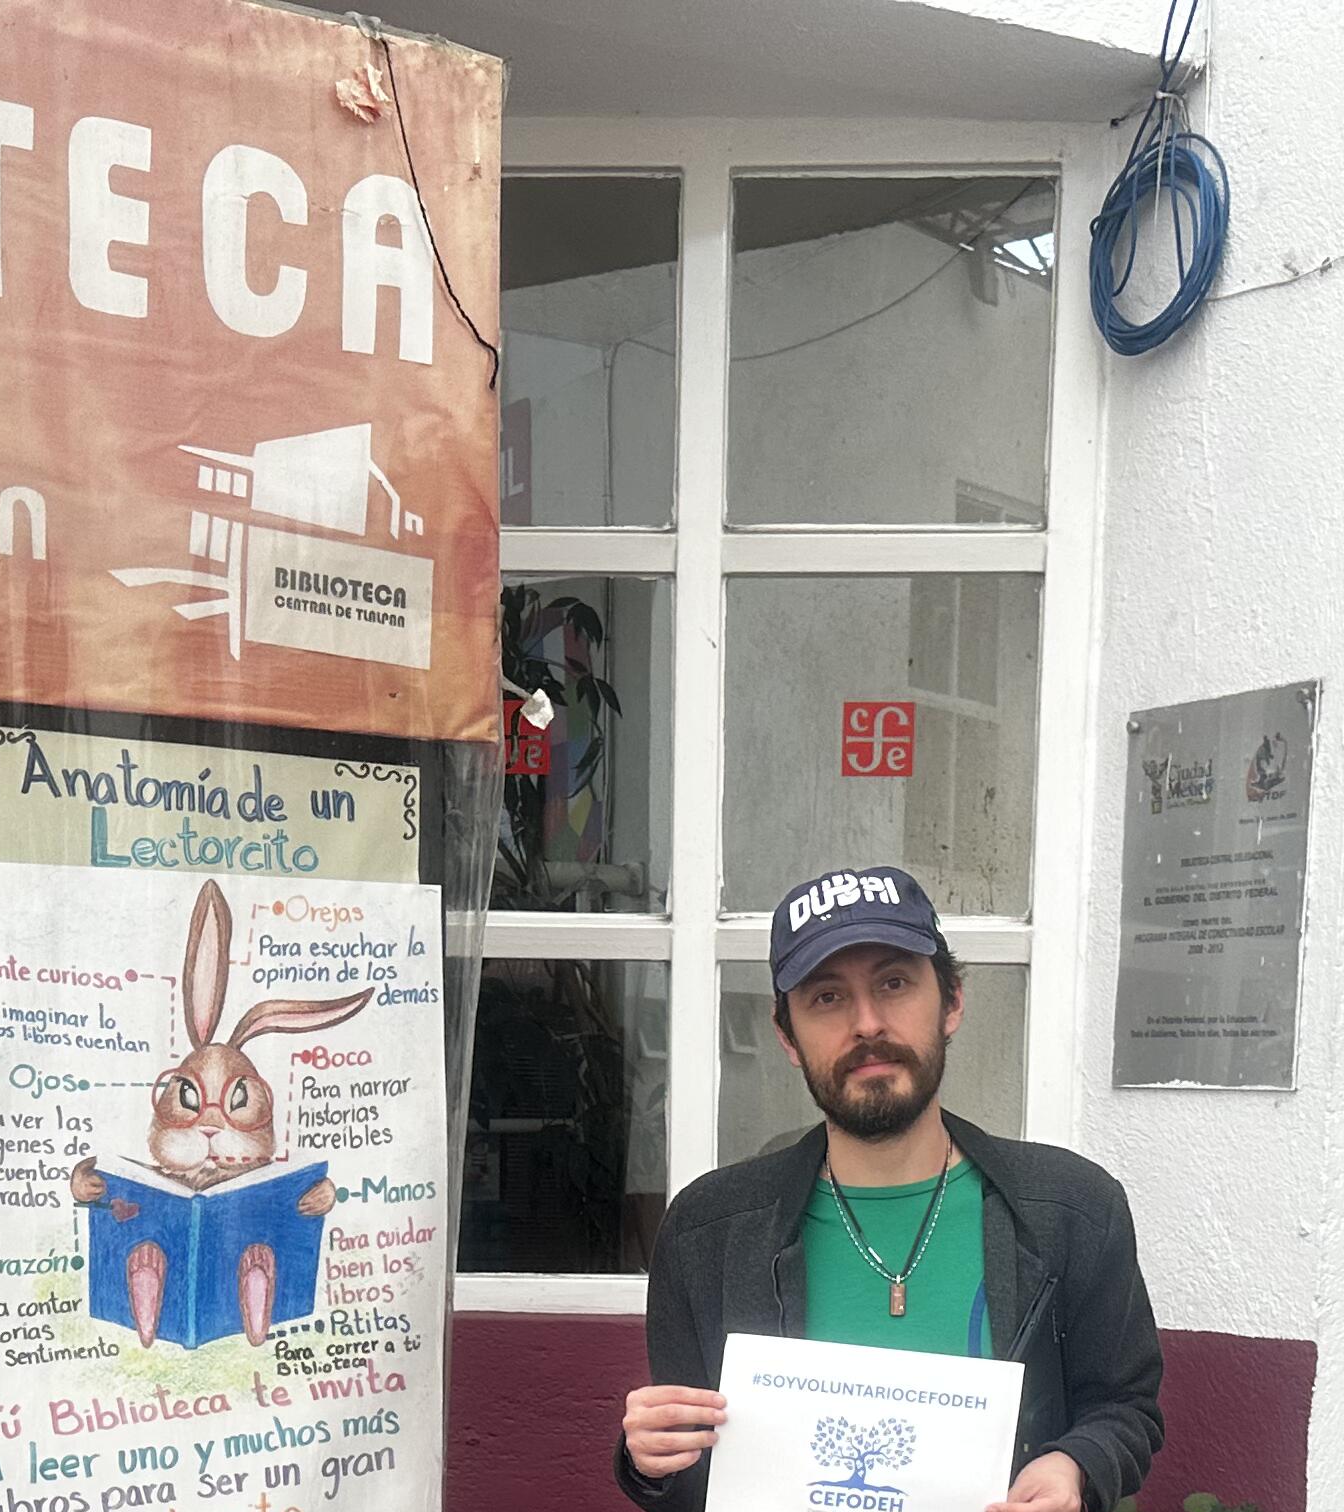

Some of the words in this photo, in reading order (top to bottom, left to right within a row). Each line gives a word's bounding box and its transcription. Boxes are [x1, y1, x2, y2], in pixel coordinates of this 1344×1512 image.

[274, 567, 407, 609] BIBLIOTECA
[274, 595, 333, 616] CENTRAL
[335, 605, 352, 619] DE
[355, 608, 406, 628] TLALPAN
[21, 739, 231, 819] Anatomía
[237, 763, 288, 823] de
[310, 789, 356, 823] un
[91, 806, 320, 874] Lectorcito
[284, 895, 365, 932] Orejas
[258, 935, 303, 959] Para
[309, 932, 398, 960] escuchar
[407, 926, 426, 958] la
[253, 957, 331, 990] opinión
[335, 958, 360, 982] de
[366, 959, 398, 981] los
[376, 981, 440, 1008] demás
[311, 1045, 373, 1068] Boca
[300, 1076, 341, 1101] Para
[349, 1076, 411, 1098] narrar
[297, 1102, 379, 1129] historias
[297, 1125, 394, 1150] increíbles
[49, 1384, 232, 1436] Biblioteca
[252, 1371, 289, 1409] te
[309, 1358, 407, 1401] invita
[752, 1372, 988, 1411] #SOYVOLUNTARIOCEFODEH
[29, 1441, 100, 1484] leer
[117, 1441, 180, 1474] uno
[194, 1440, 216, 1474] y
[223, 1416, 332, 1461] muchos
[342, 1407, 401, 1437] más
[196, 1470, 249, 1498] ser
[264, 1462, 302, 1490] un
[321, 1446, 396, 1500] gran
